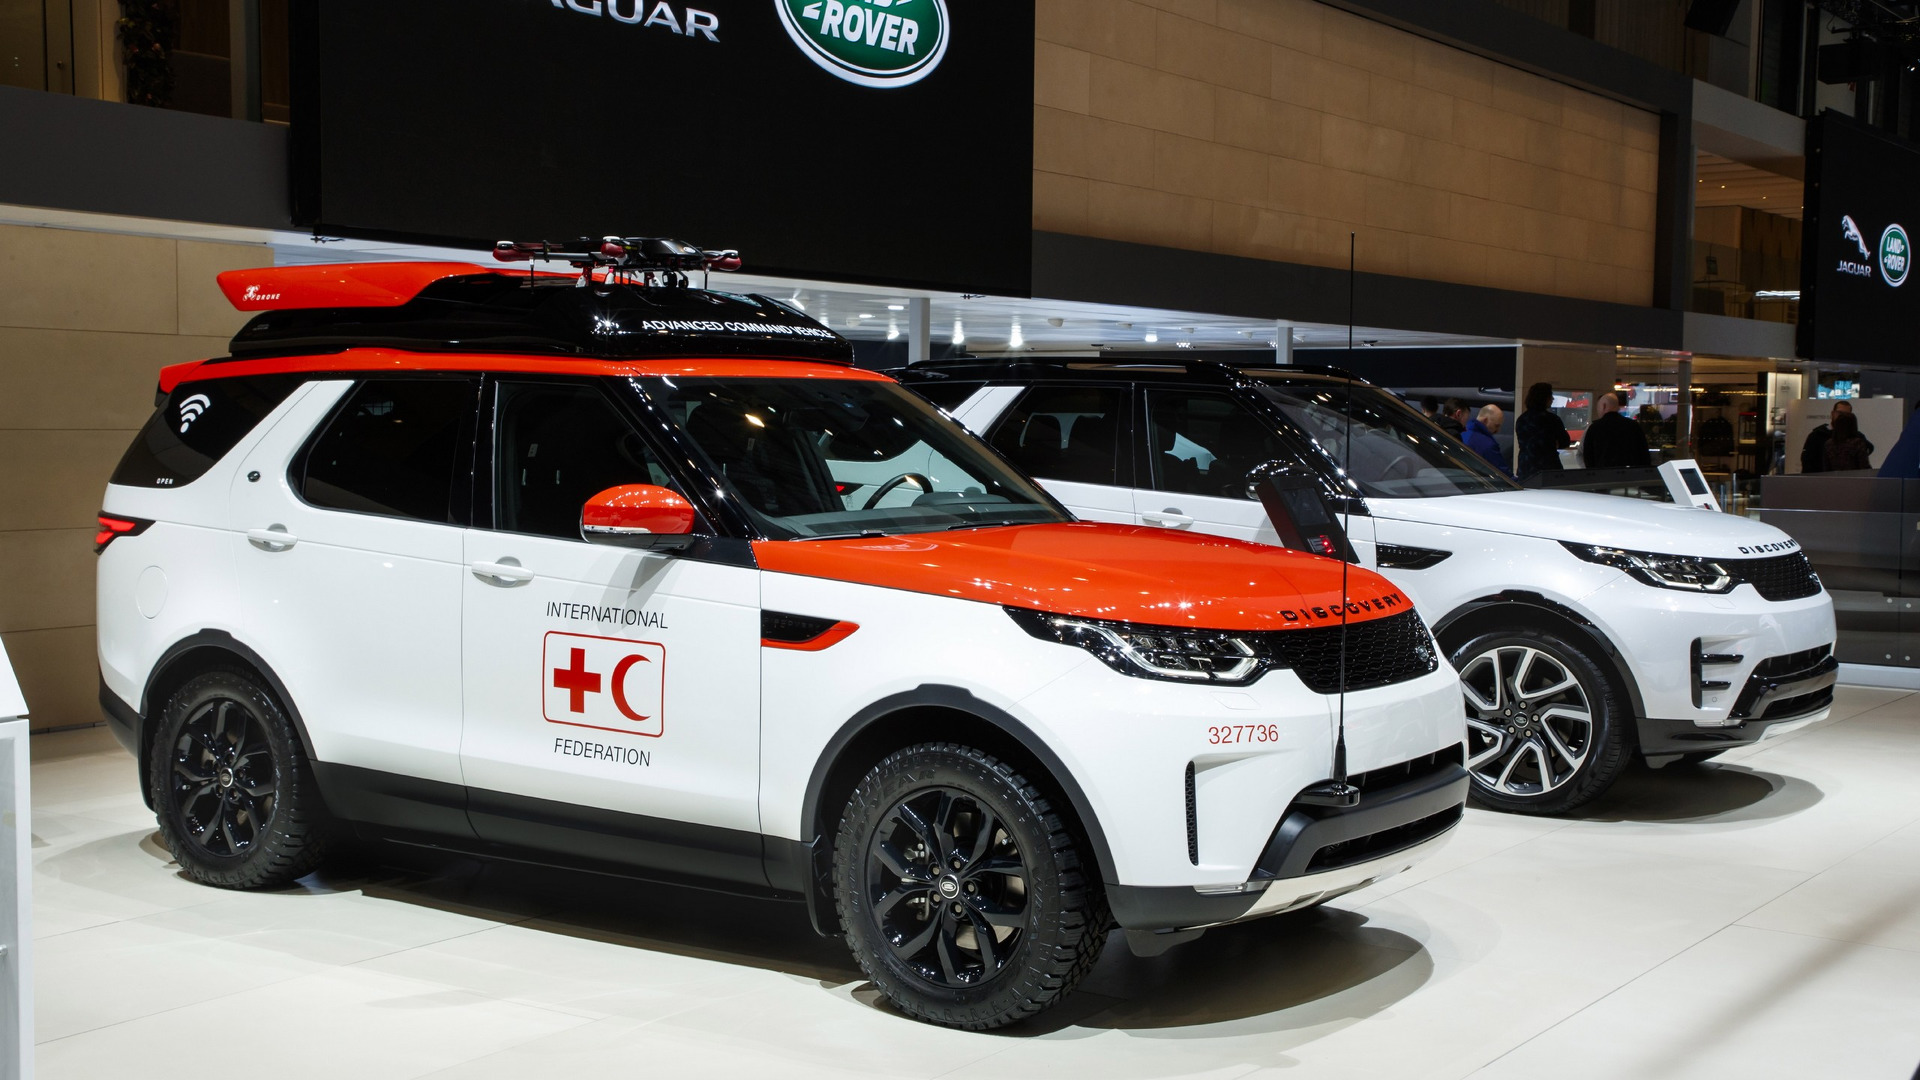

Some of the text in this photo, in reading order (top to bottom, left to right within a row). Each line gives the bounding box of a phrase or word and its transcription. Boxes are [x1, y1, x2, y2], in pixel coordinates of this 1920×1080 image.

[820, 0, 919, 56] ROVER
[1886, 236, 1902, 254] LAND
[1836, 260, 1871, 277] JAGUAR
[1887, 253, 1905, 272] ROVER
[256, 293, 280, 301] DRONE
[642, 320, 836, 339] ADVANCED COMMAND VEHICLE
[156, 477, 174, 485] OPEN
[546, 601, 669, 630] INTERNATIONAL
[1280, 593, 1402, 622] DISCOVERY
[1208, 724, 1279, 745] 327736
[554, 737, 651, 767] FEDERATION
